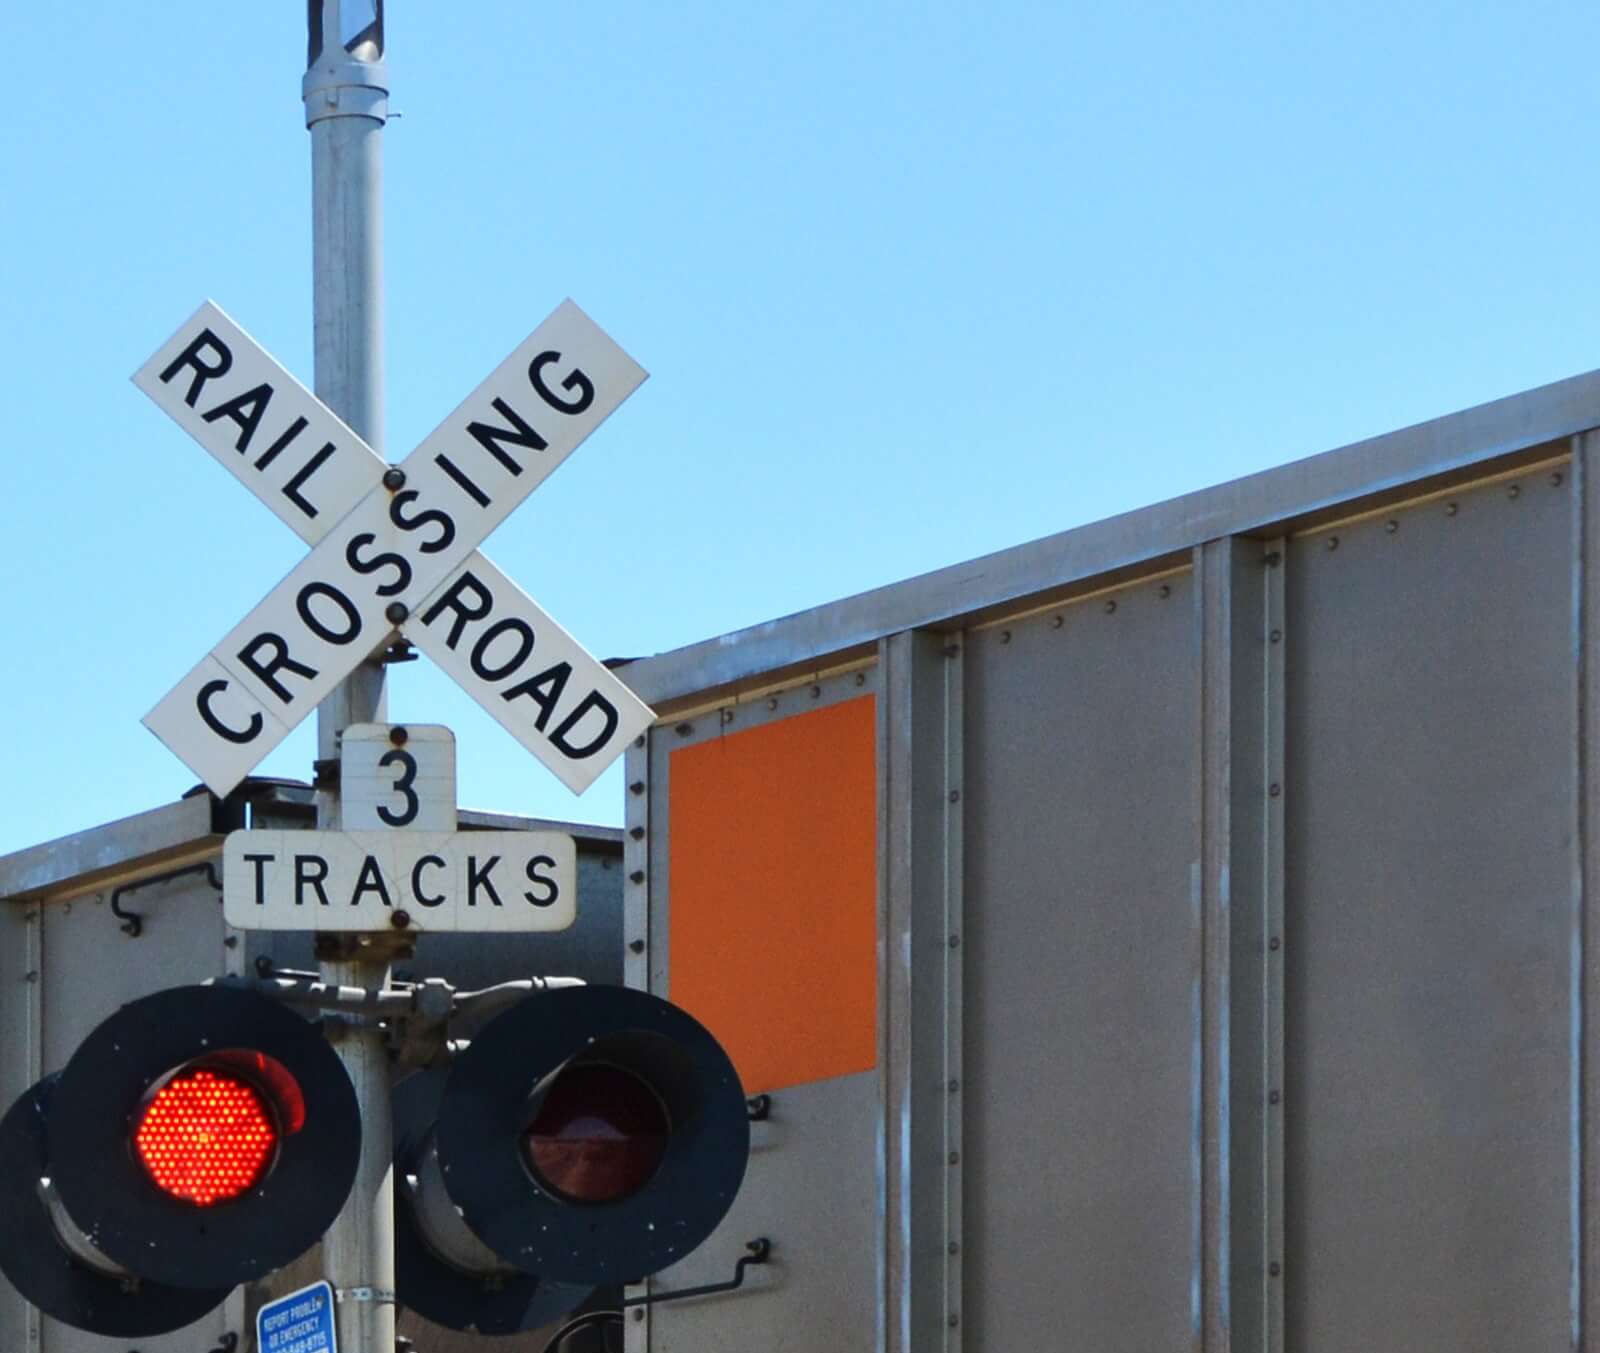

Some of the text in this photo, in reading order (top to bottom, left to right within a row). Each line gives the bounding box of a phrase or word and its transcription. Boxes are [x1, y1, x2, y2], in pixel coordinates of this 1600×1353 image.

[158, 327, 619, 760] RAIL ROAD
[195, 350, 596, 745] CROSSING
[243, 854, 559, 907] TRACKS
[376, 749, 419, 827] 3
